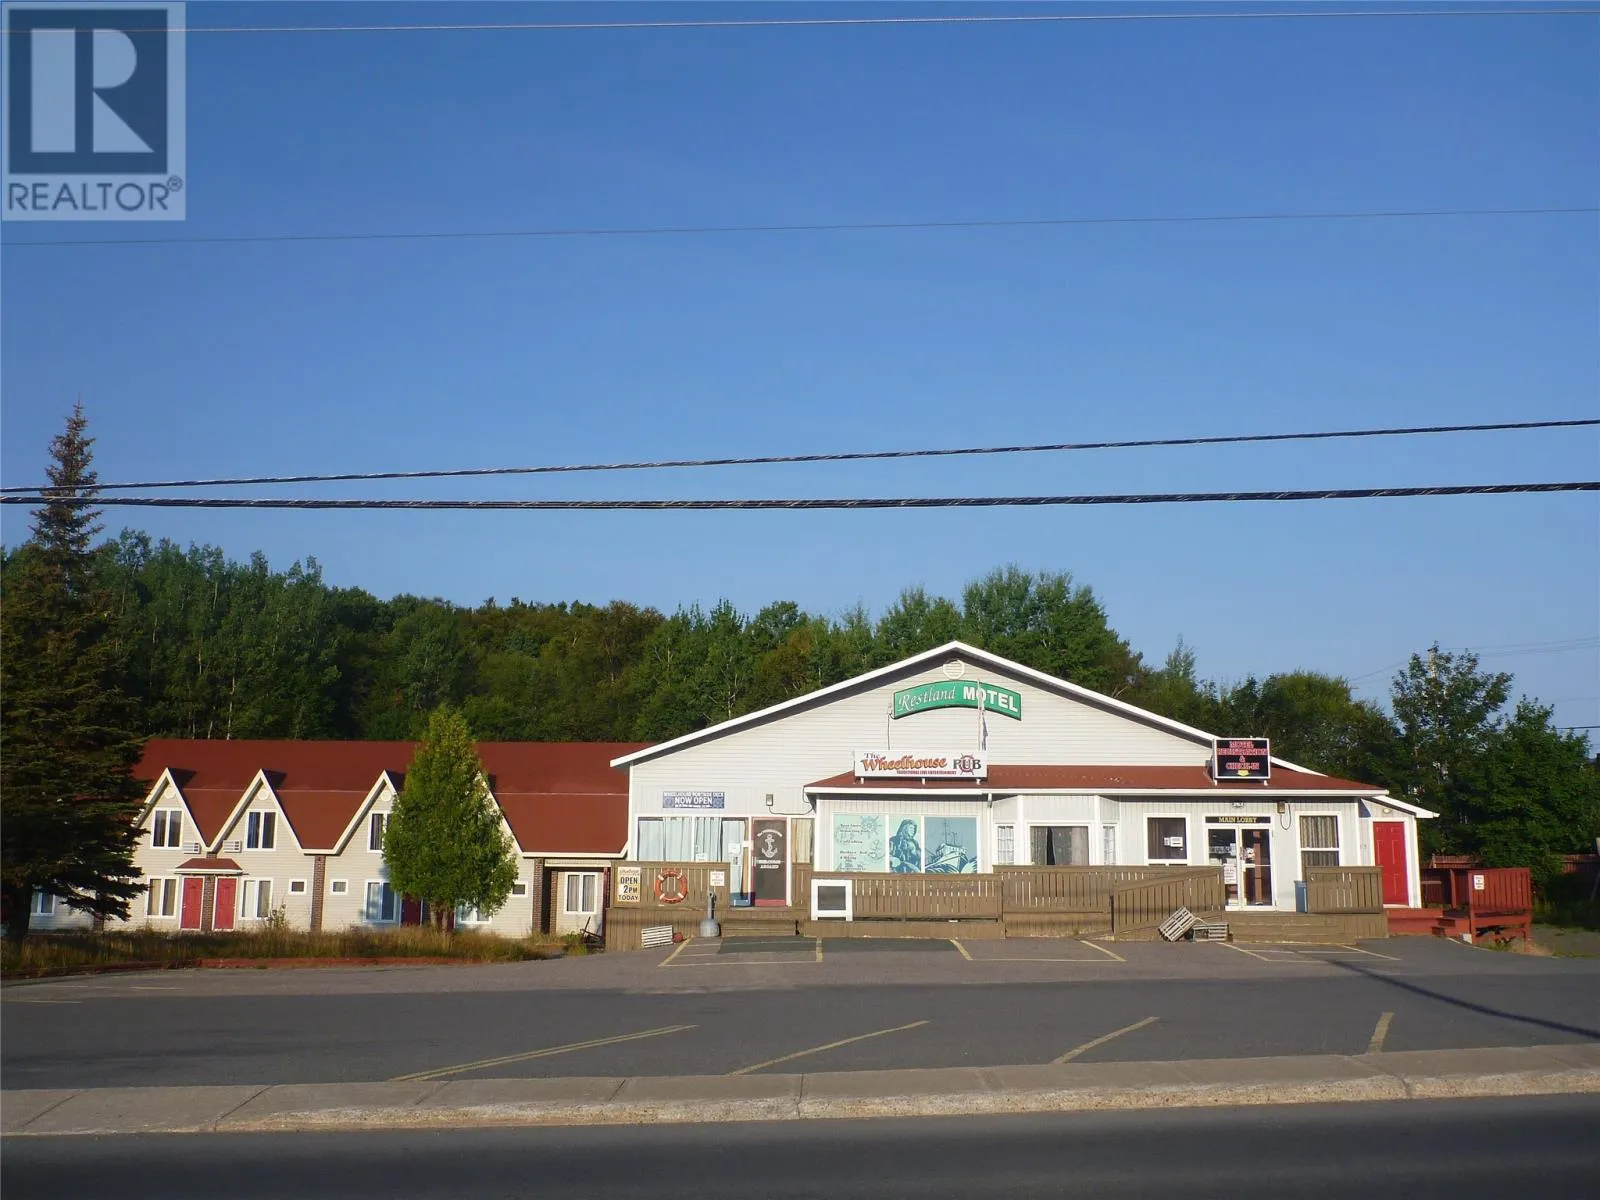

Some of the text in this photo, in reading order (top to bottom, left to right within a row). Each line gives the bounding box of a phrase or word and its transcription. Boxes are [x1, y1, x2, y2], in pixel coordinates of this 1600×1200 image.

[897, 686, 1019, 712] Restland MOTEL
[860, 755, 982, 772] Wheelhouse PUB
[674, 797, 713, 805] NOW OPEN
[620, 876, 638, 884] OPEN
